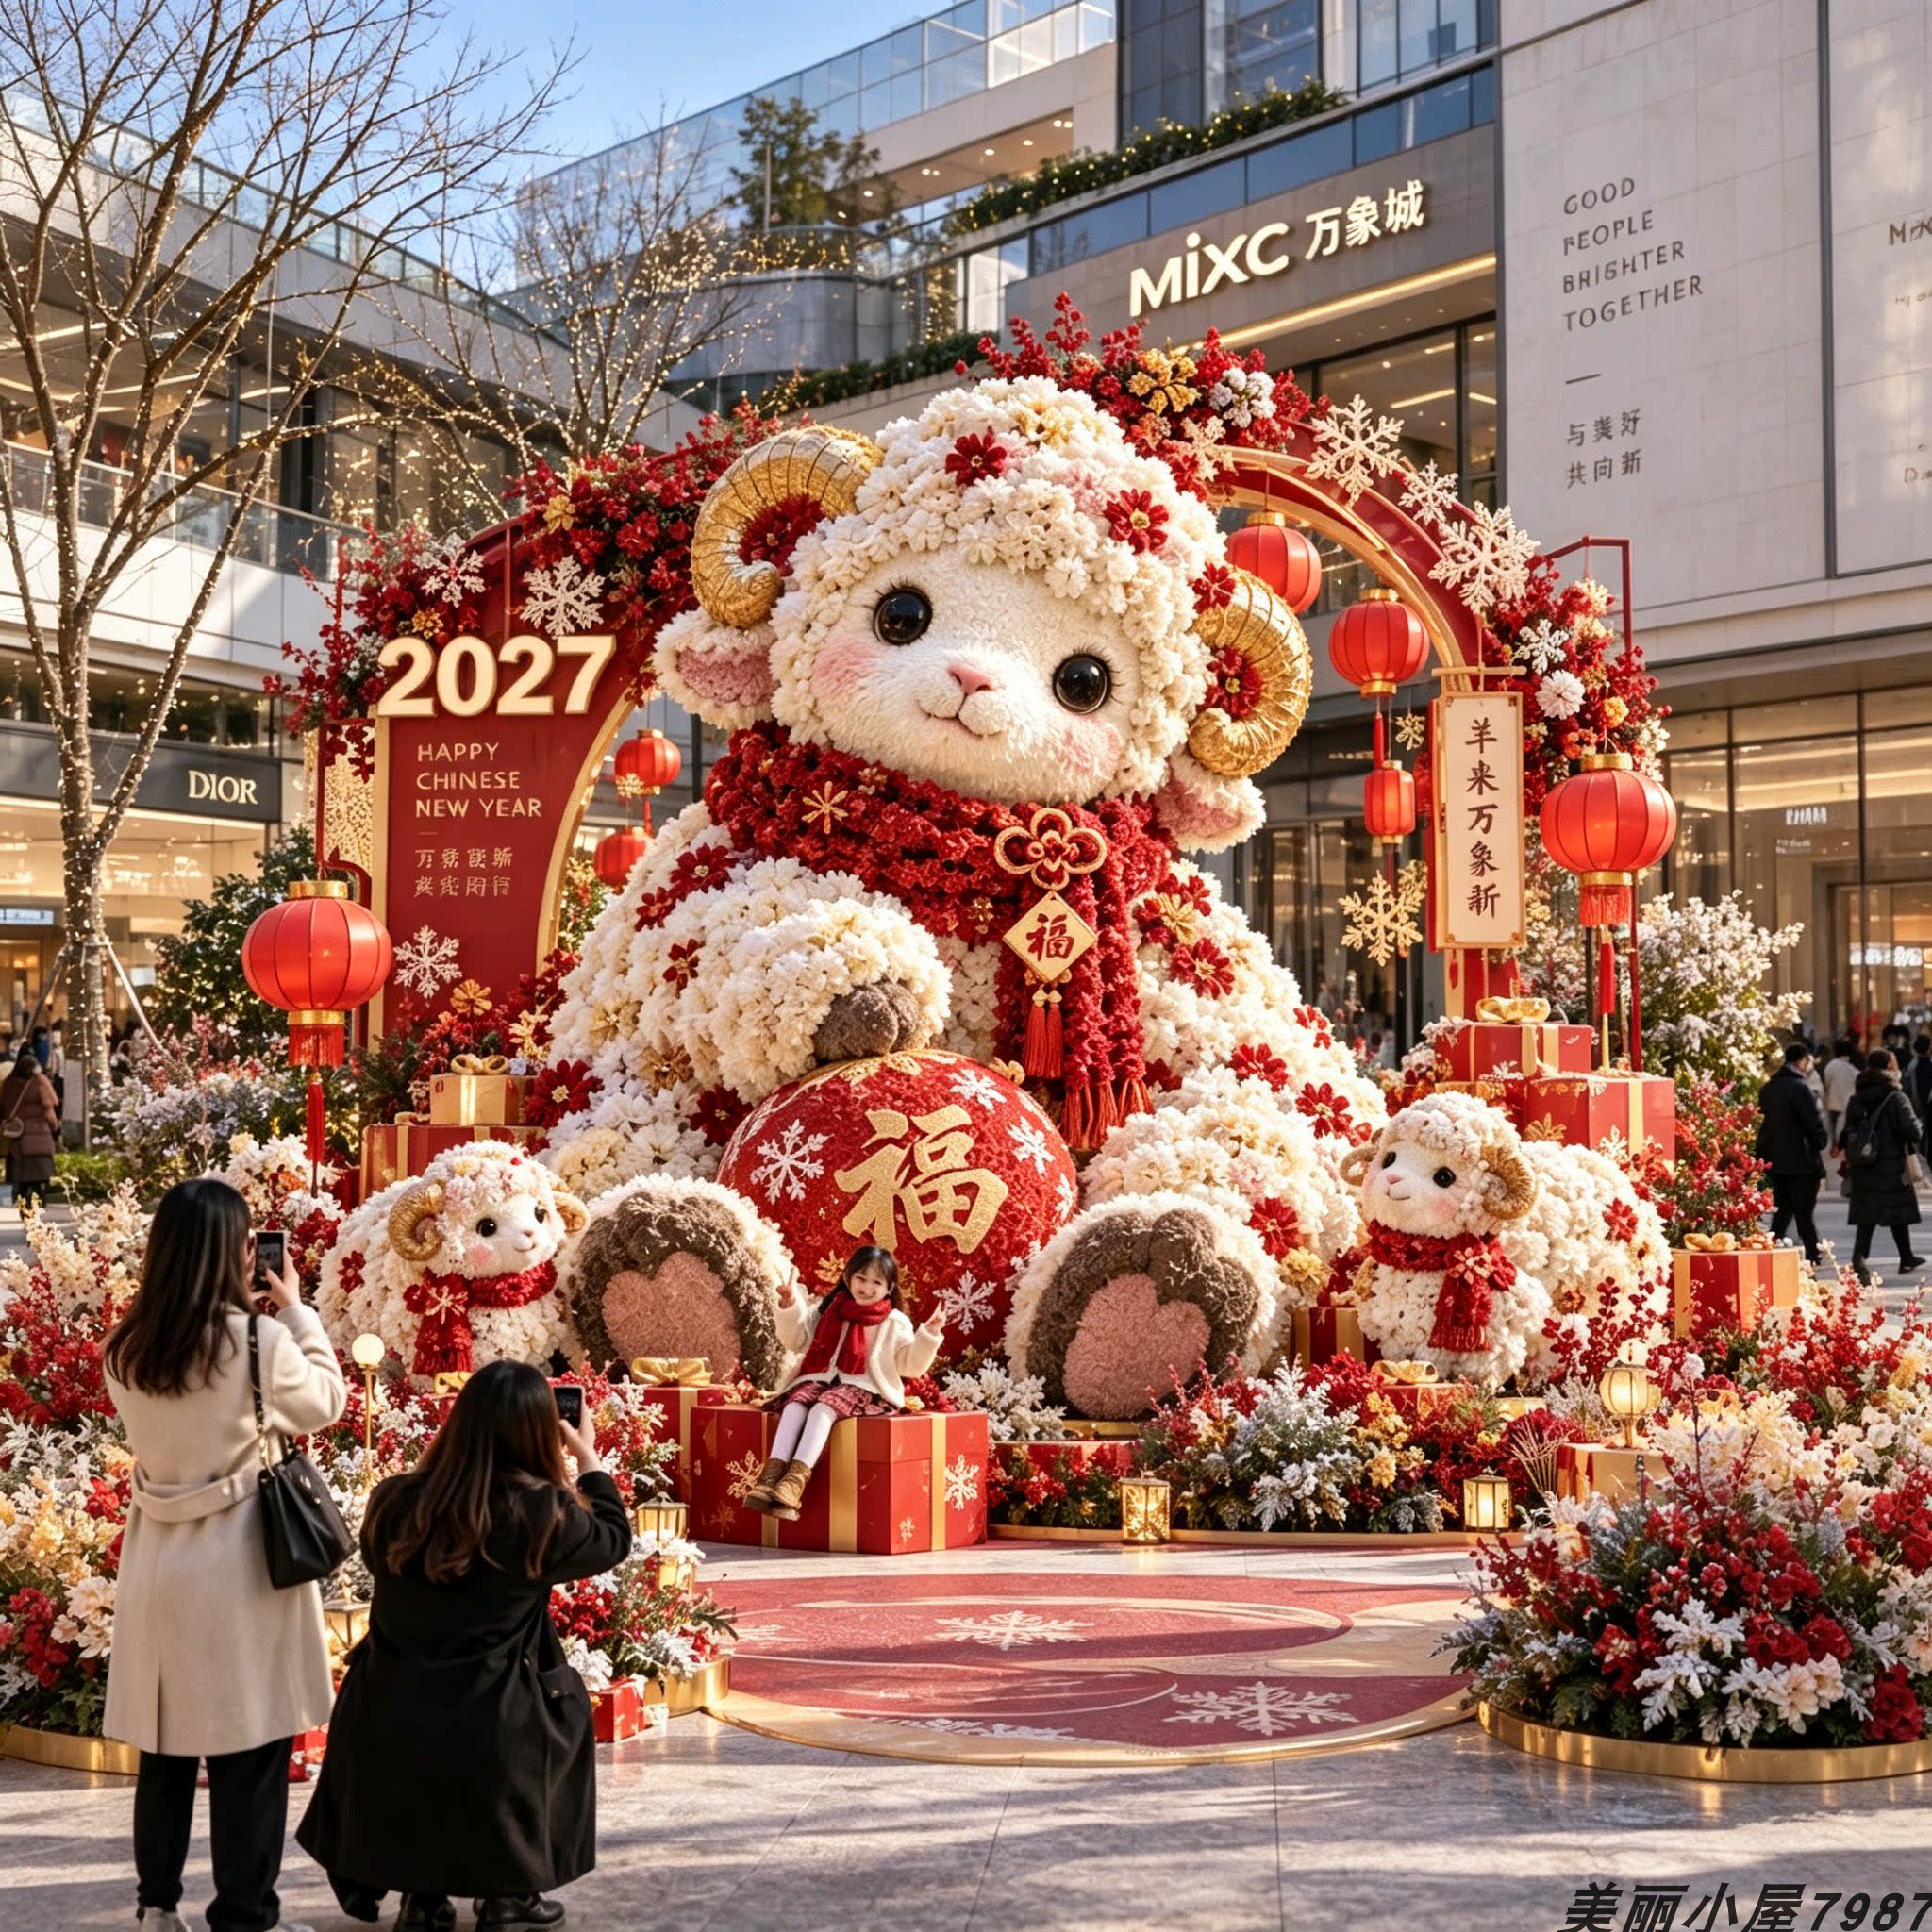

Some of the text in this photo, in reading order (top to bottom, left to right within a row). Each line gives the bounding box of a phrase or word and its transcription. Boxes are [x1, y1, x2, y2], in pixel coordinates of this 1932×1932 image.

[1305, 179, 1425, 260] 万象城
[1563, 177, 1635, 215] GOOD
[1563, 209, 1653, 256] PEOPLE
[1563, 241, 1685, 294] BRIGHTER
[1562, 275, 1704, 331] TOGETHER
[377, 635, 616, 717] 2027
[417, 741, 500, 762] HAPPY
[188, 770, 258, 805] DIOR
[416, 771, 521, 791] CHINESE
[415, 797, 543, 819] NEW YEAR
[1465, 717, 1502, 920] 羊来万象新
[1025, 912, 1075, 963] 福
[833, 1103, 1009, 1256] 福
